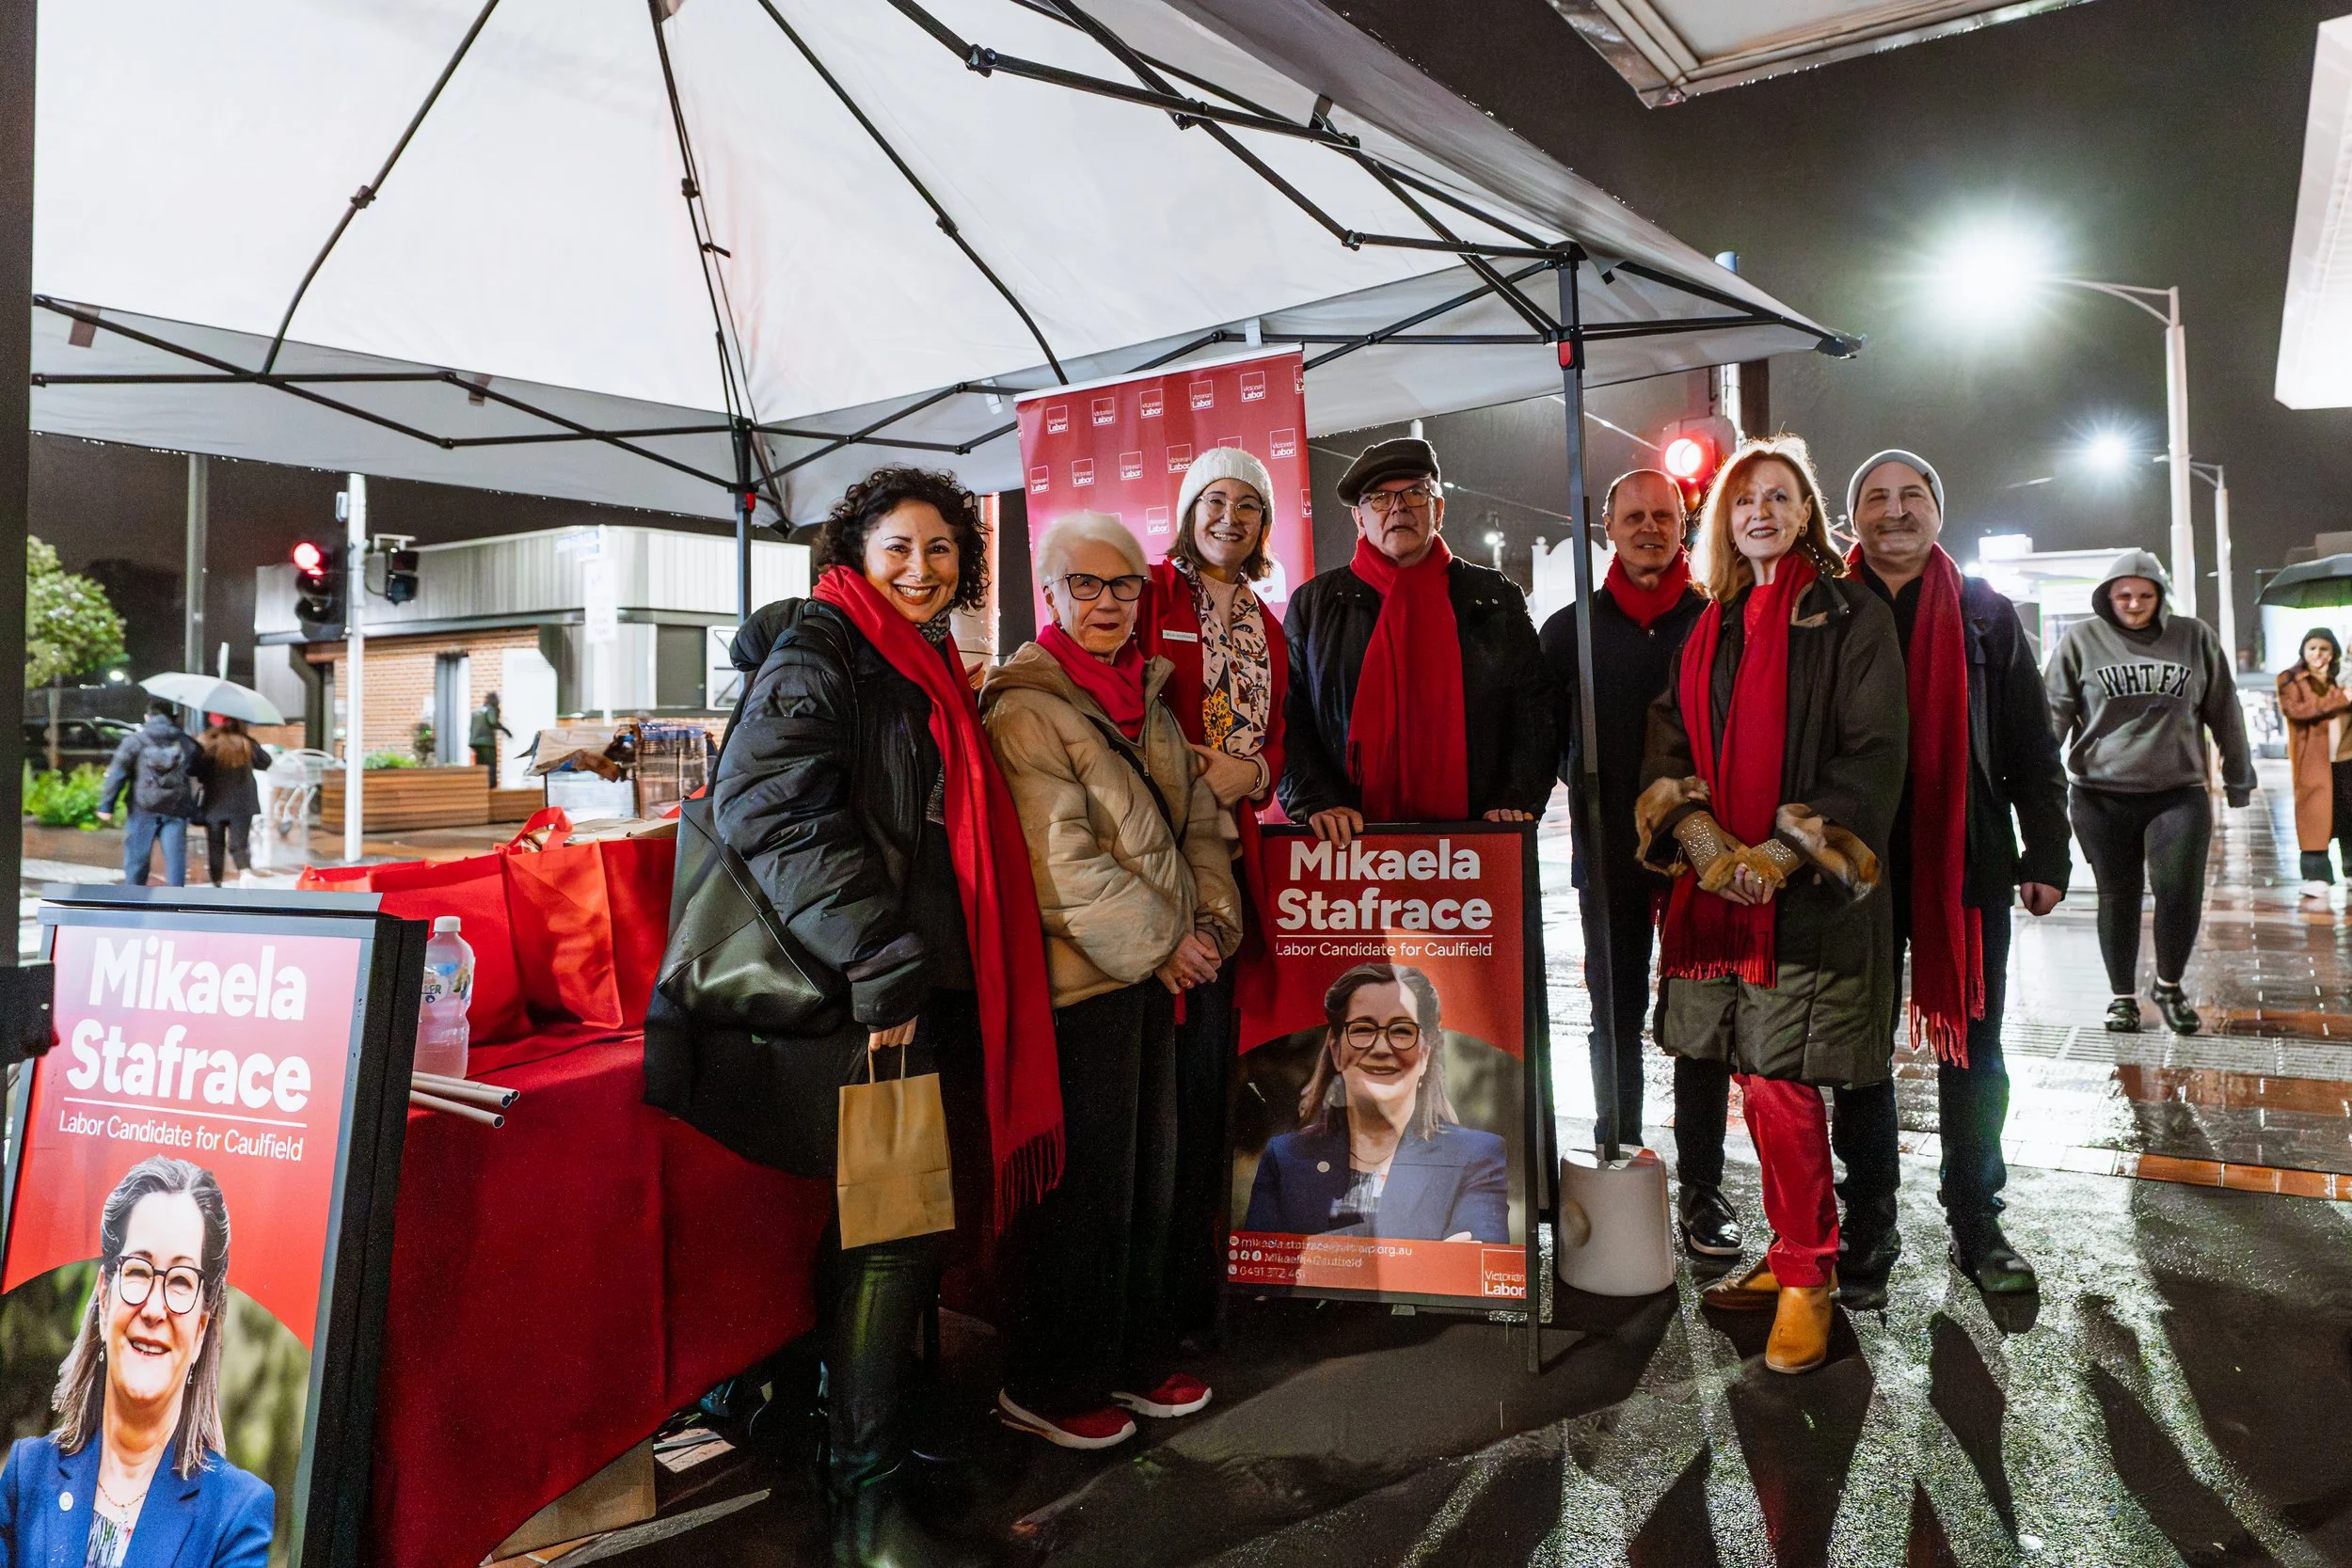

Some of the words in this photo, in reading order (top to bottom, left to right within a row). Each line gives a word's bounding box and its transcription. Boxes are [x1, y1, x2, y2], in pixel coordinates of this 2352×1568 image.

[1243, 390, 1263, 401] Labor
[1192, 399, 1212, 408] Labor
[1141, 407, 1162, 417] Labor
[1093, 416, 1114, 424] Labor
[1048, 422, 1068, 432] Labor
[1272, 448, 1295, 457] Labor
[1121, 469, 1141, 479] Labor
[1073, 477, 1093, 485] Labor
[1030, 483, 1048, 492] Labor
[1148, 524, 1168, 533] Labor
[1289, 838, 1481, 881] Mikaela
[1276, 887, 1493, 930] Stafrace
[1276, 942, 1316, 957] Labor
[1319, 942, 1396, 958] Candidate
[1399, 942, 1422, 957] for
[1424, 942, 1492, 957] Caulfield
[88, 935, 308, 1022] Mikaela
[66, 1019, 311, 1113] Stafrace
[58, 1110, 105, 1138] Labor
[106, 1116, 193, 1148] Candidate
[195, 1129, 222, 1151] for
[224, 1130, 306, 1163] Caulfield
[1485, 1270, 1525, 1282] Victorian
[1484, 1280, 1525, 1297] Labor
